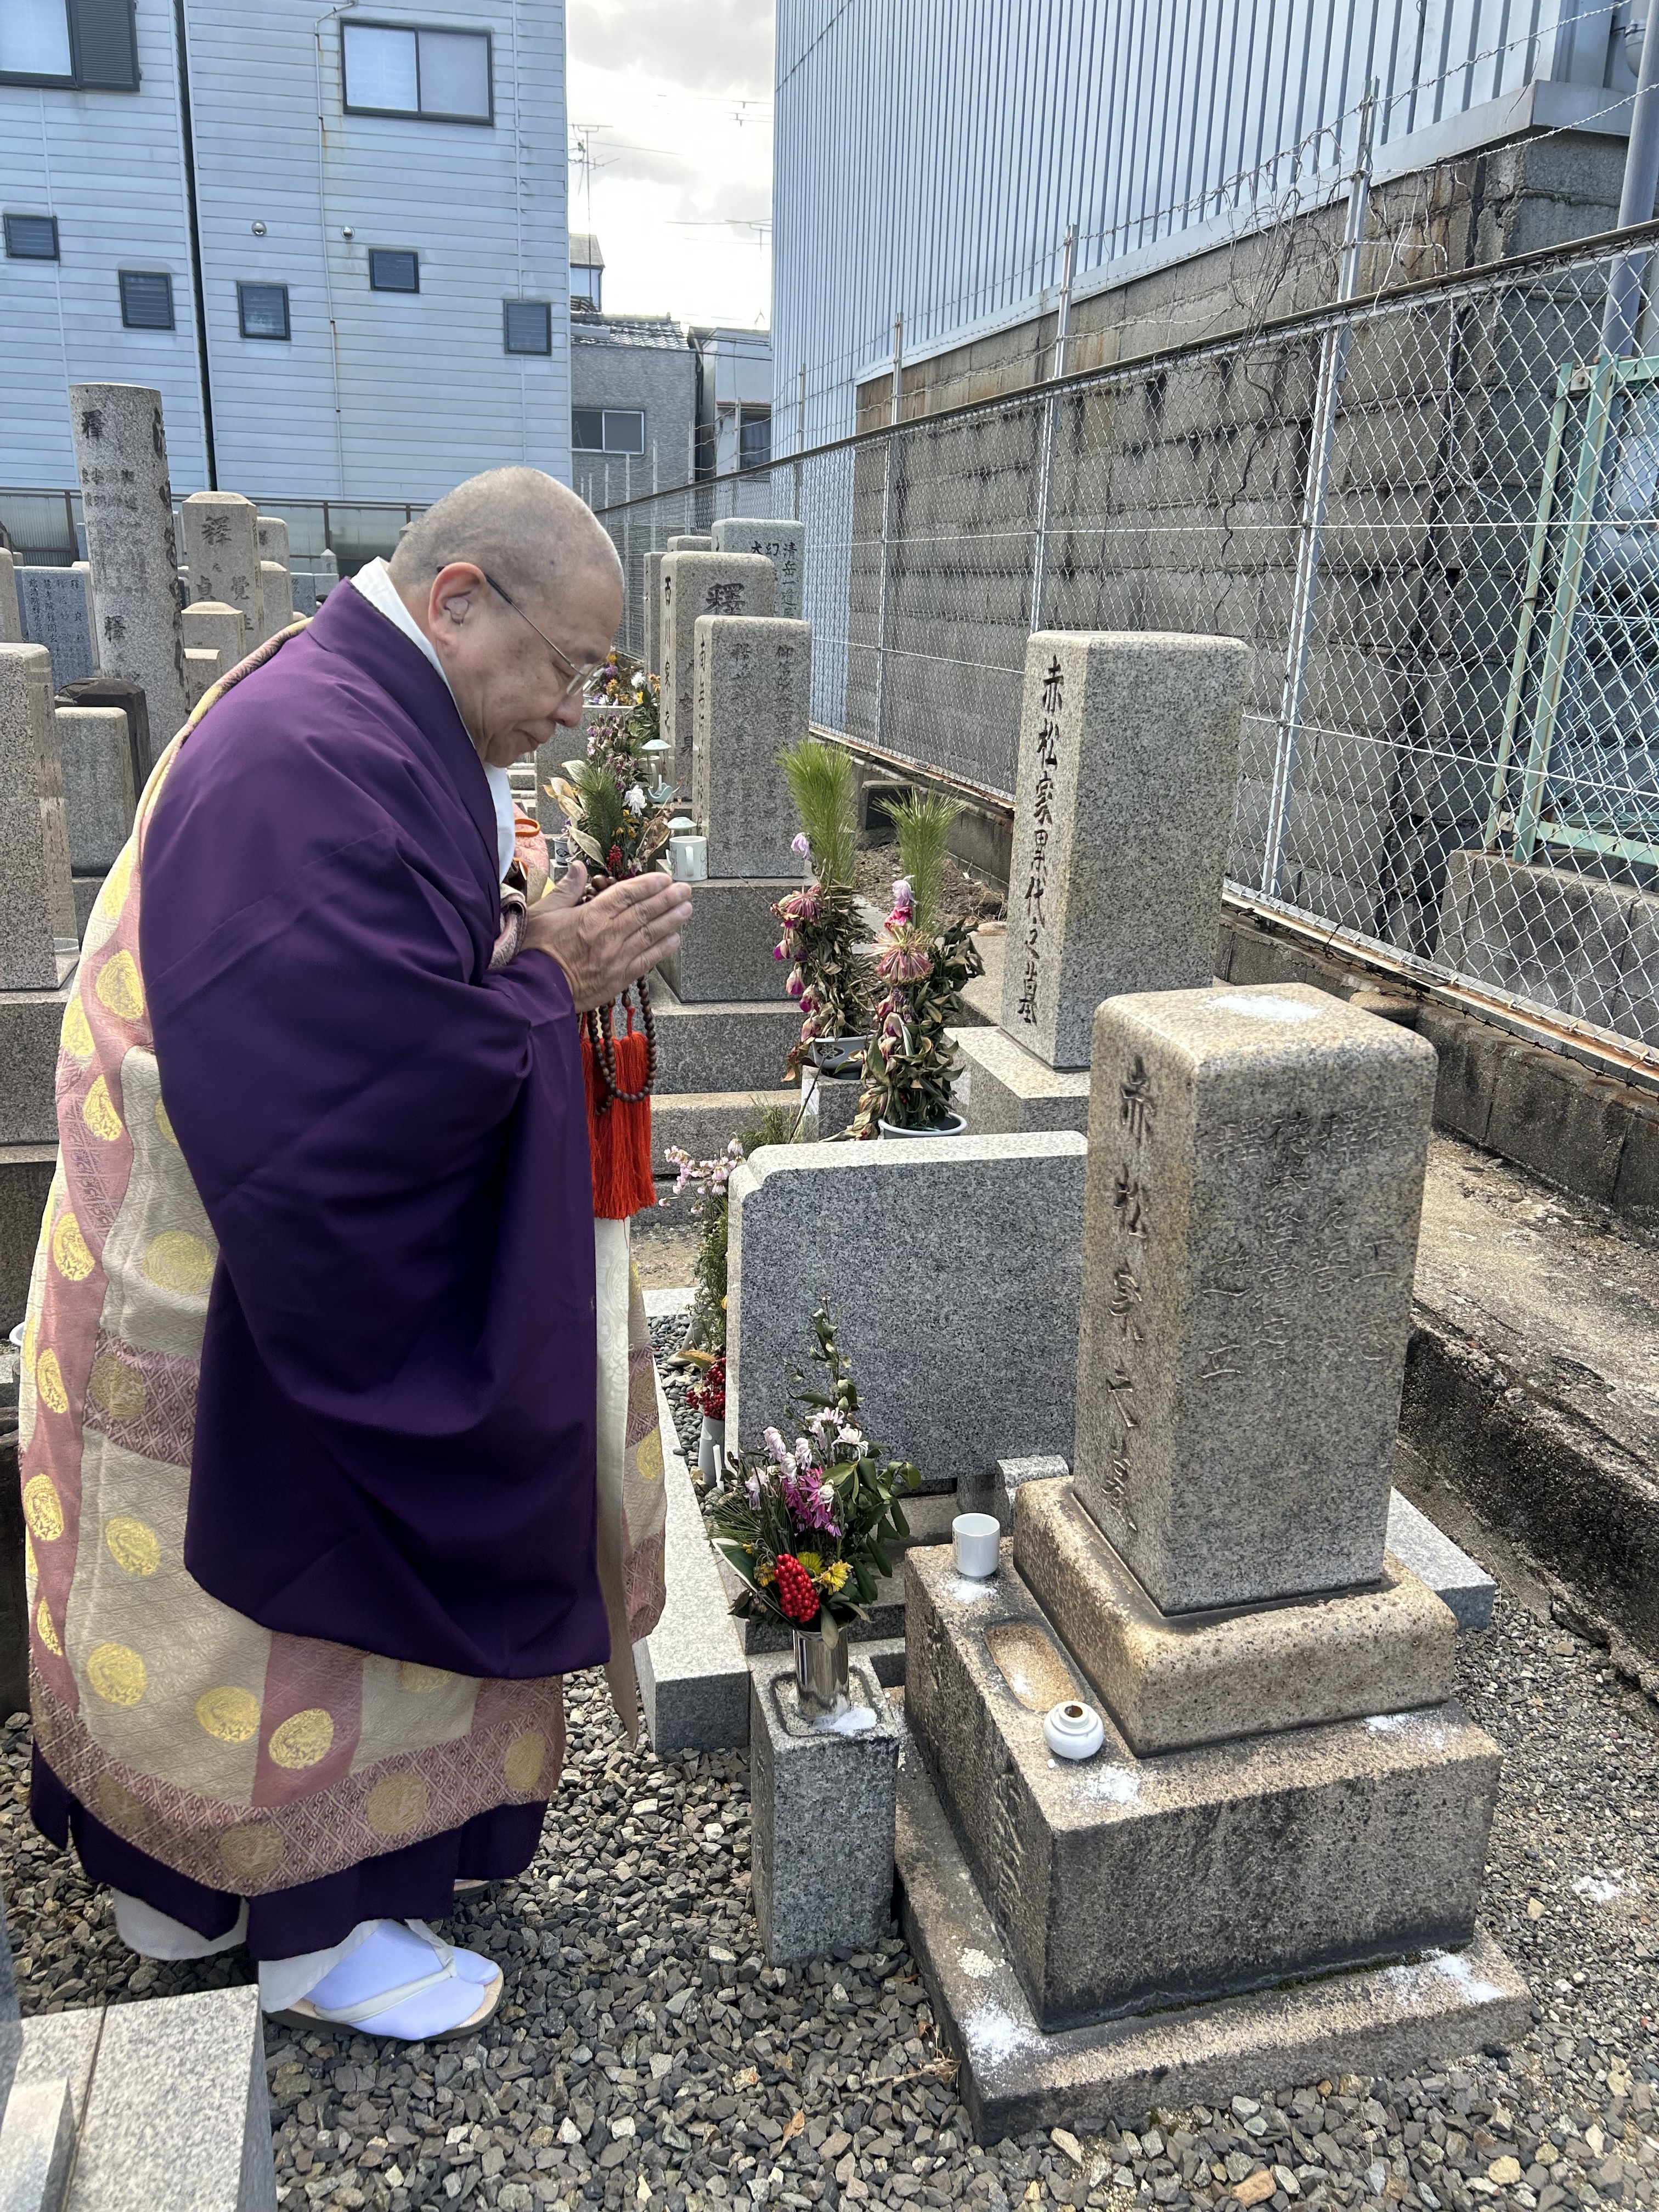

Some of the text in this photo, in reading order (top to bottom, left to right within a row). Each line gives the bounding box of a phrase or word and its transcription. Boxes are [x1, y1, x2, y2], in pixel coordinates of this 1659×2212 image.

[1018, 655, 1064, 1026] 赤松家累代之墓
